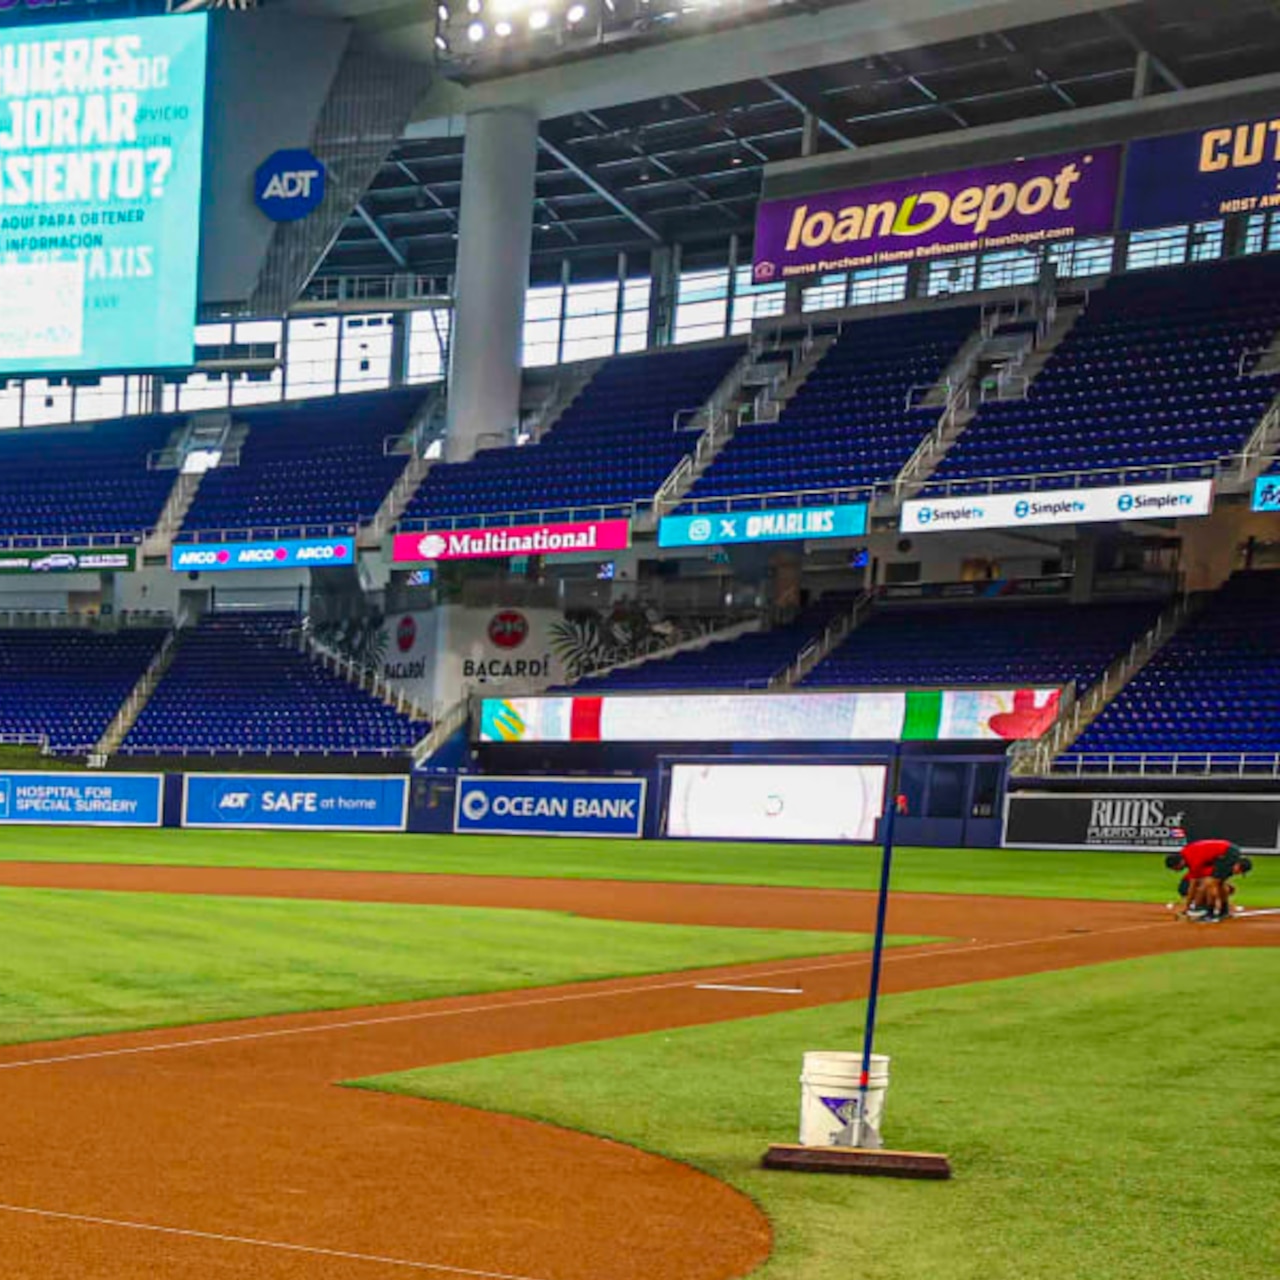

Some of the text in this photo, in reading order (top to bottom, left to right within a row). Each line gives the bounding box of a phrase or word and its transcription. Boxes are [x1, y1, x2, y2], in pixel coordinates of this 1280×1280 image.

[261, 169, 318, 199] ADT
[785, 163, 1081, 251] loanDepot
[39, 212, 75, 228] PARA
[80, 209, 145, 226] OBTENER
[448, 525, 596, 555] Multinational
[178, 545, 334, 564] ARCO ARCO ARCO
[463, 654, 551, 678] BACARDÍ
[16, 786, 112, 799] HOSPITAL FOR
[219, 792, 250, 808] ADT
[261, 791, 377, 812] SAFE at home
[16, 799, 138, 812] SPECIAL SURGERY
[492, 795, 636, 819] OCEAN BANK
